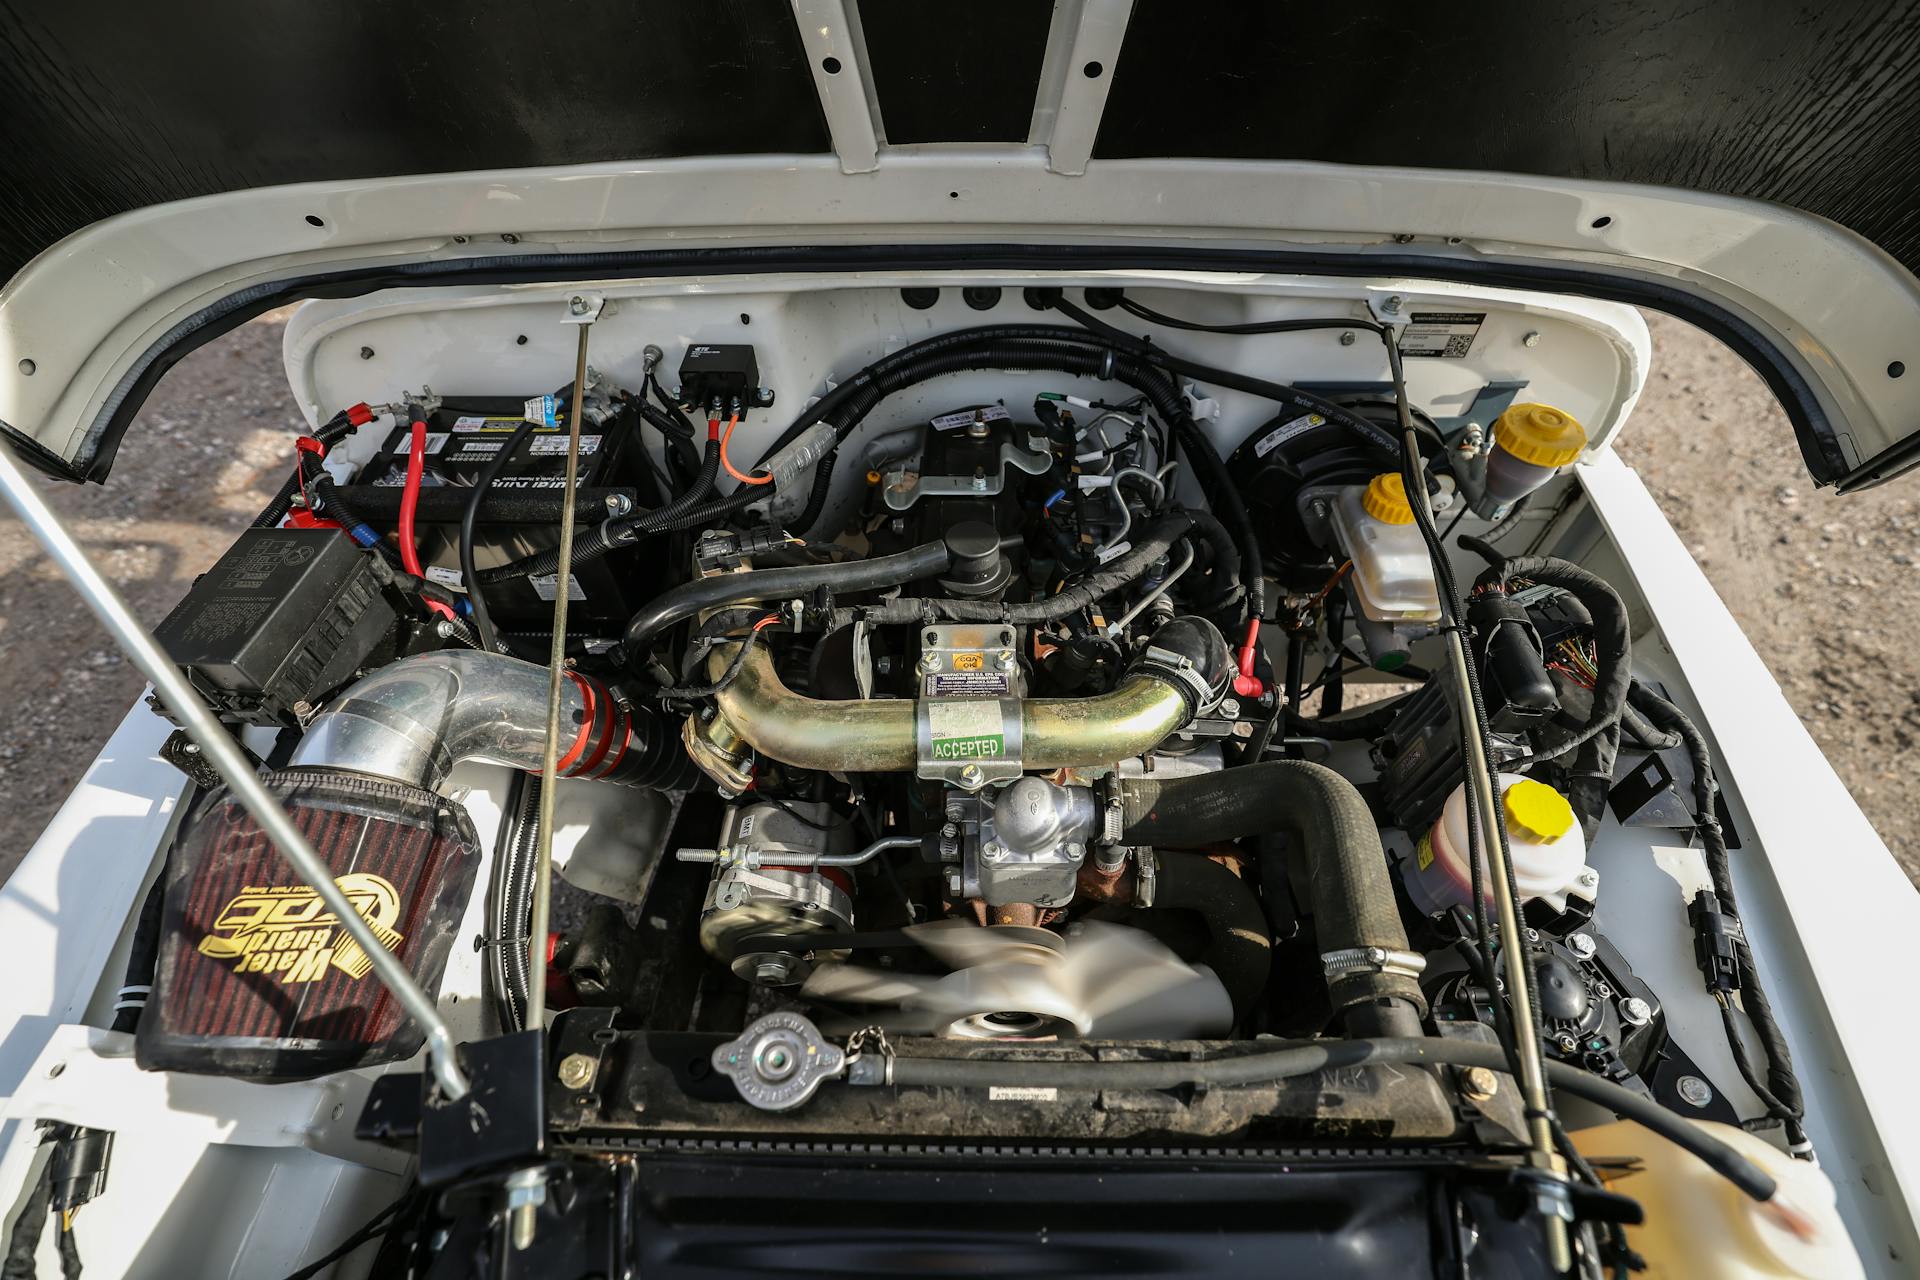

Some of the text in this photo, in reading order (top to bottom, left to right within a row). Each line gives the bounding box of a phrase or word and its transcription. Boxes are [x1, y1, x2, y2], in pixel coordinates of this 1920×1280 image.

[935, 739, 999, 760] ACCEPTED
[239, 929, 331, 957] Guard
[232, 948, 333, 984] Water
